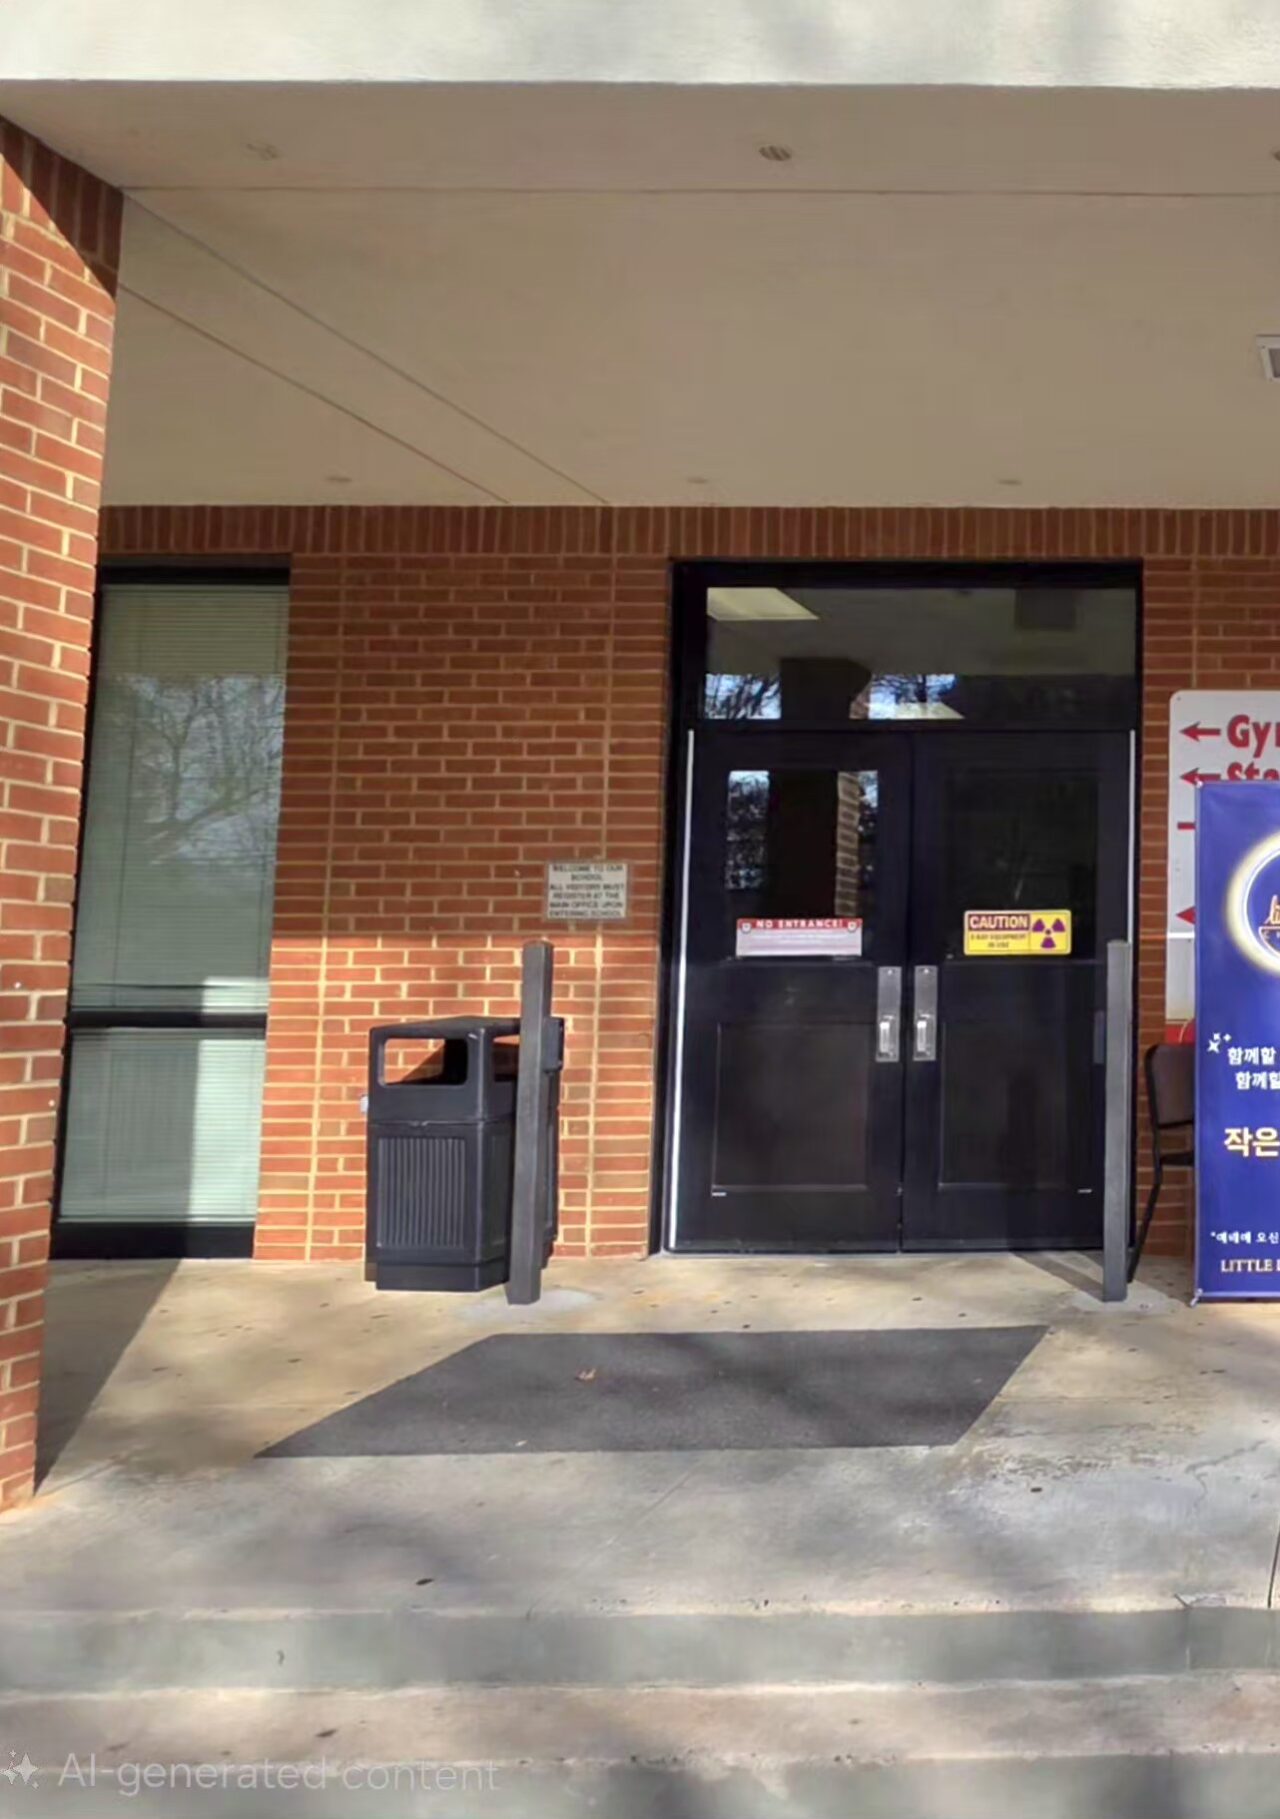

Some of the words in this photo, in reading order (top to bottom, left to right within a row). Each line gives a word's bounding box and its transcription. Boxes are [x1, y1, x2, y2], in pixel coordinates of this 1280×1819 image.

[552, 865, 590, 873] WELCOME
[755, 919, 773, 928] NO
[779, 919, 843, 928] ENTRANCE!
[969, 915, 1028, 929] CAUTION
[1227, 1047, 1276, 1065] 함께할
[1224, 1127, 1280, 1157] 작은
[1220, 1258, 1273, 1273] LITTLE
